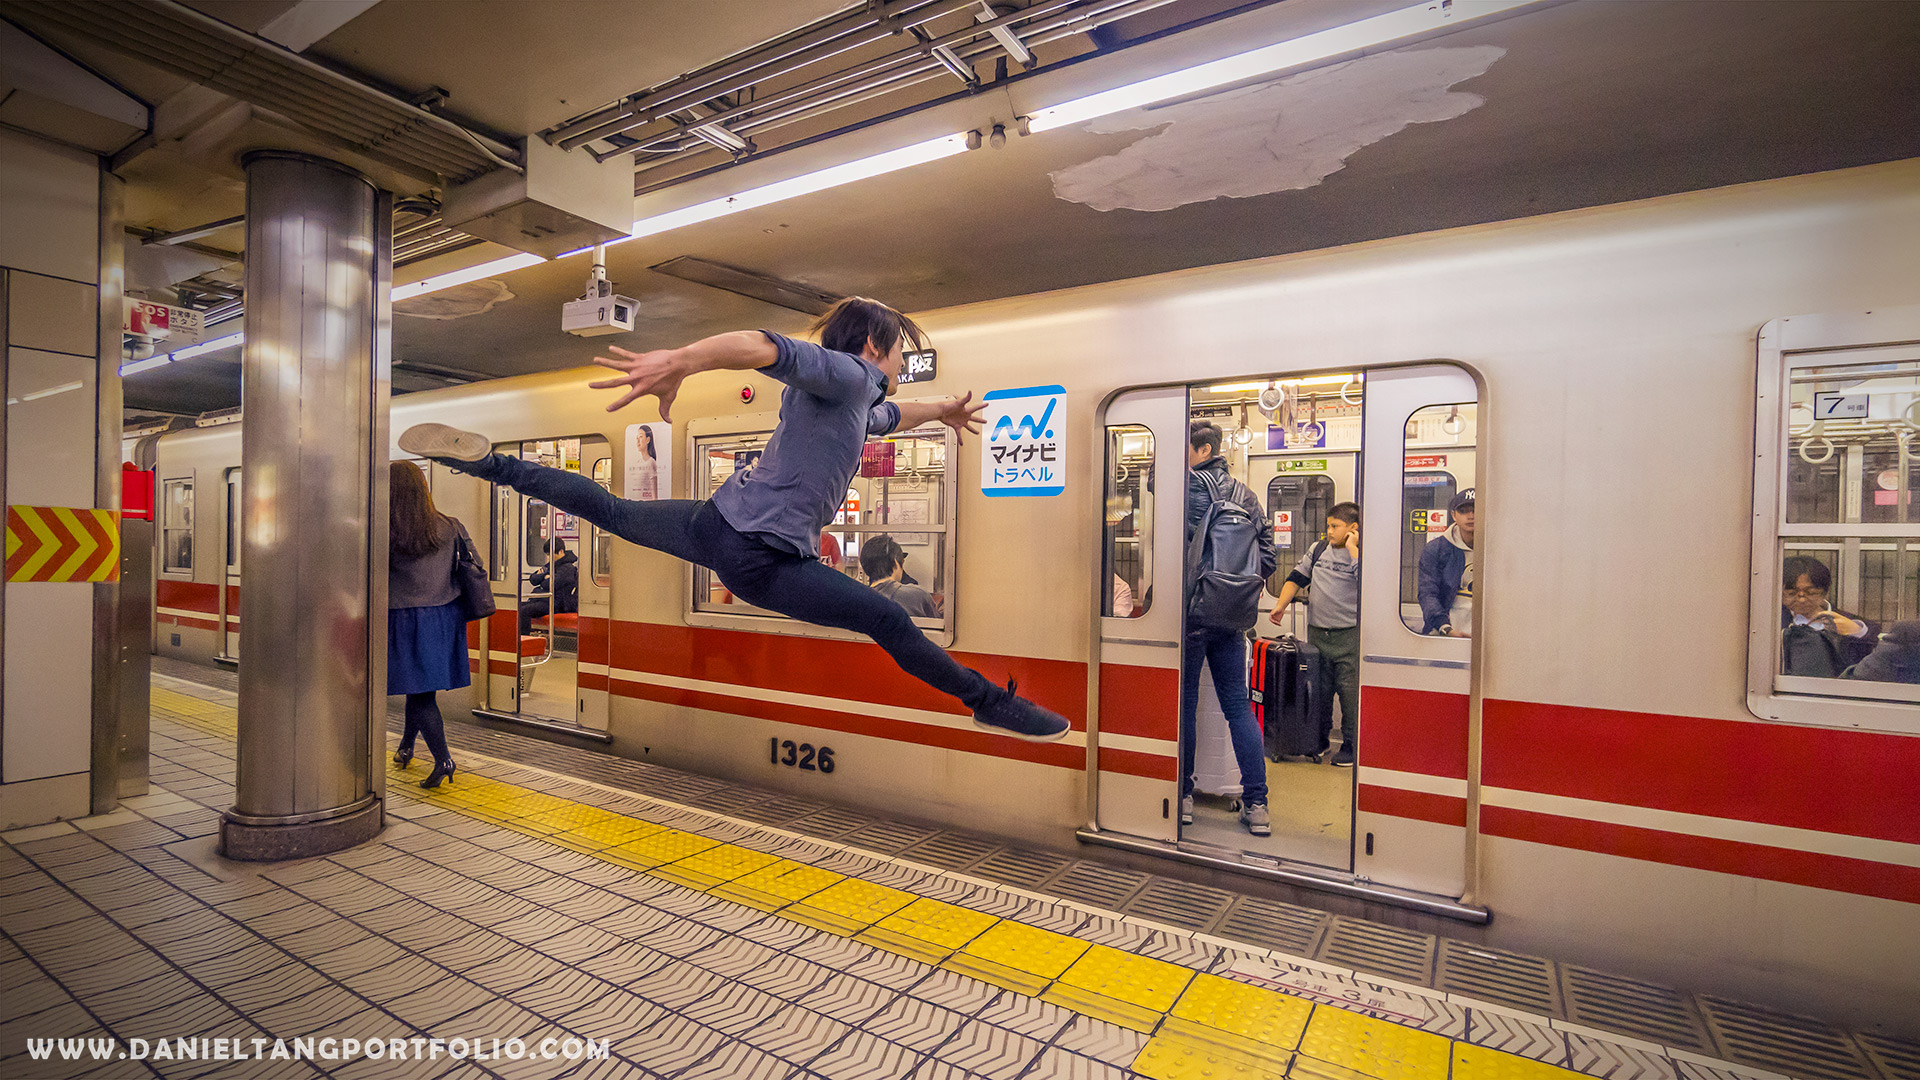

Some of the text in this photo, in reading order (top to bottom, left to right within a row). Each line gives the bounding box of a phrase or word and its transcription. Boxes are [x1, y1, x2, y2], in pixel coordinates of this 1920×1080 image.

[135, 303, 166, 317] SOS
[170, 308, 198, 321] 非常停止
[990, 443, 1056, 463] マイナビ
[994, 466, 1053, 483] トラベル
[771, 737, 835, 773] 1326
